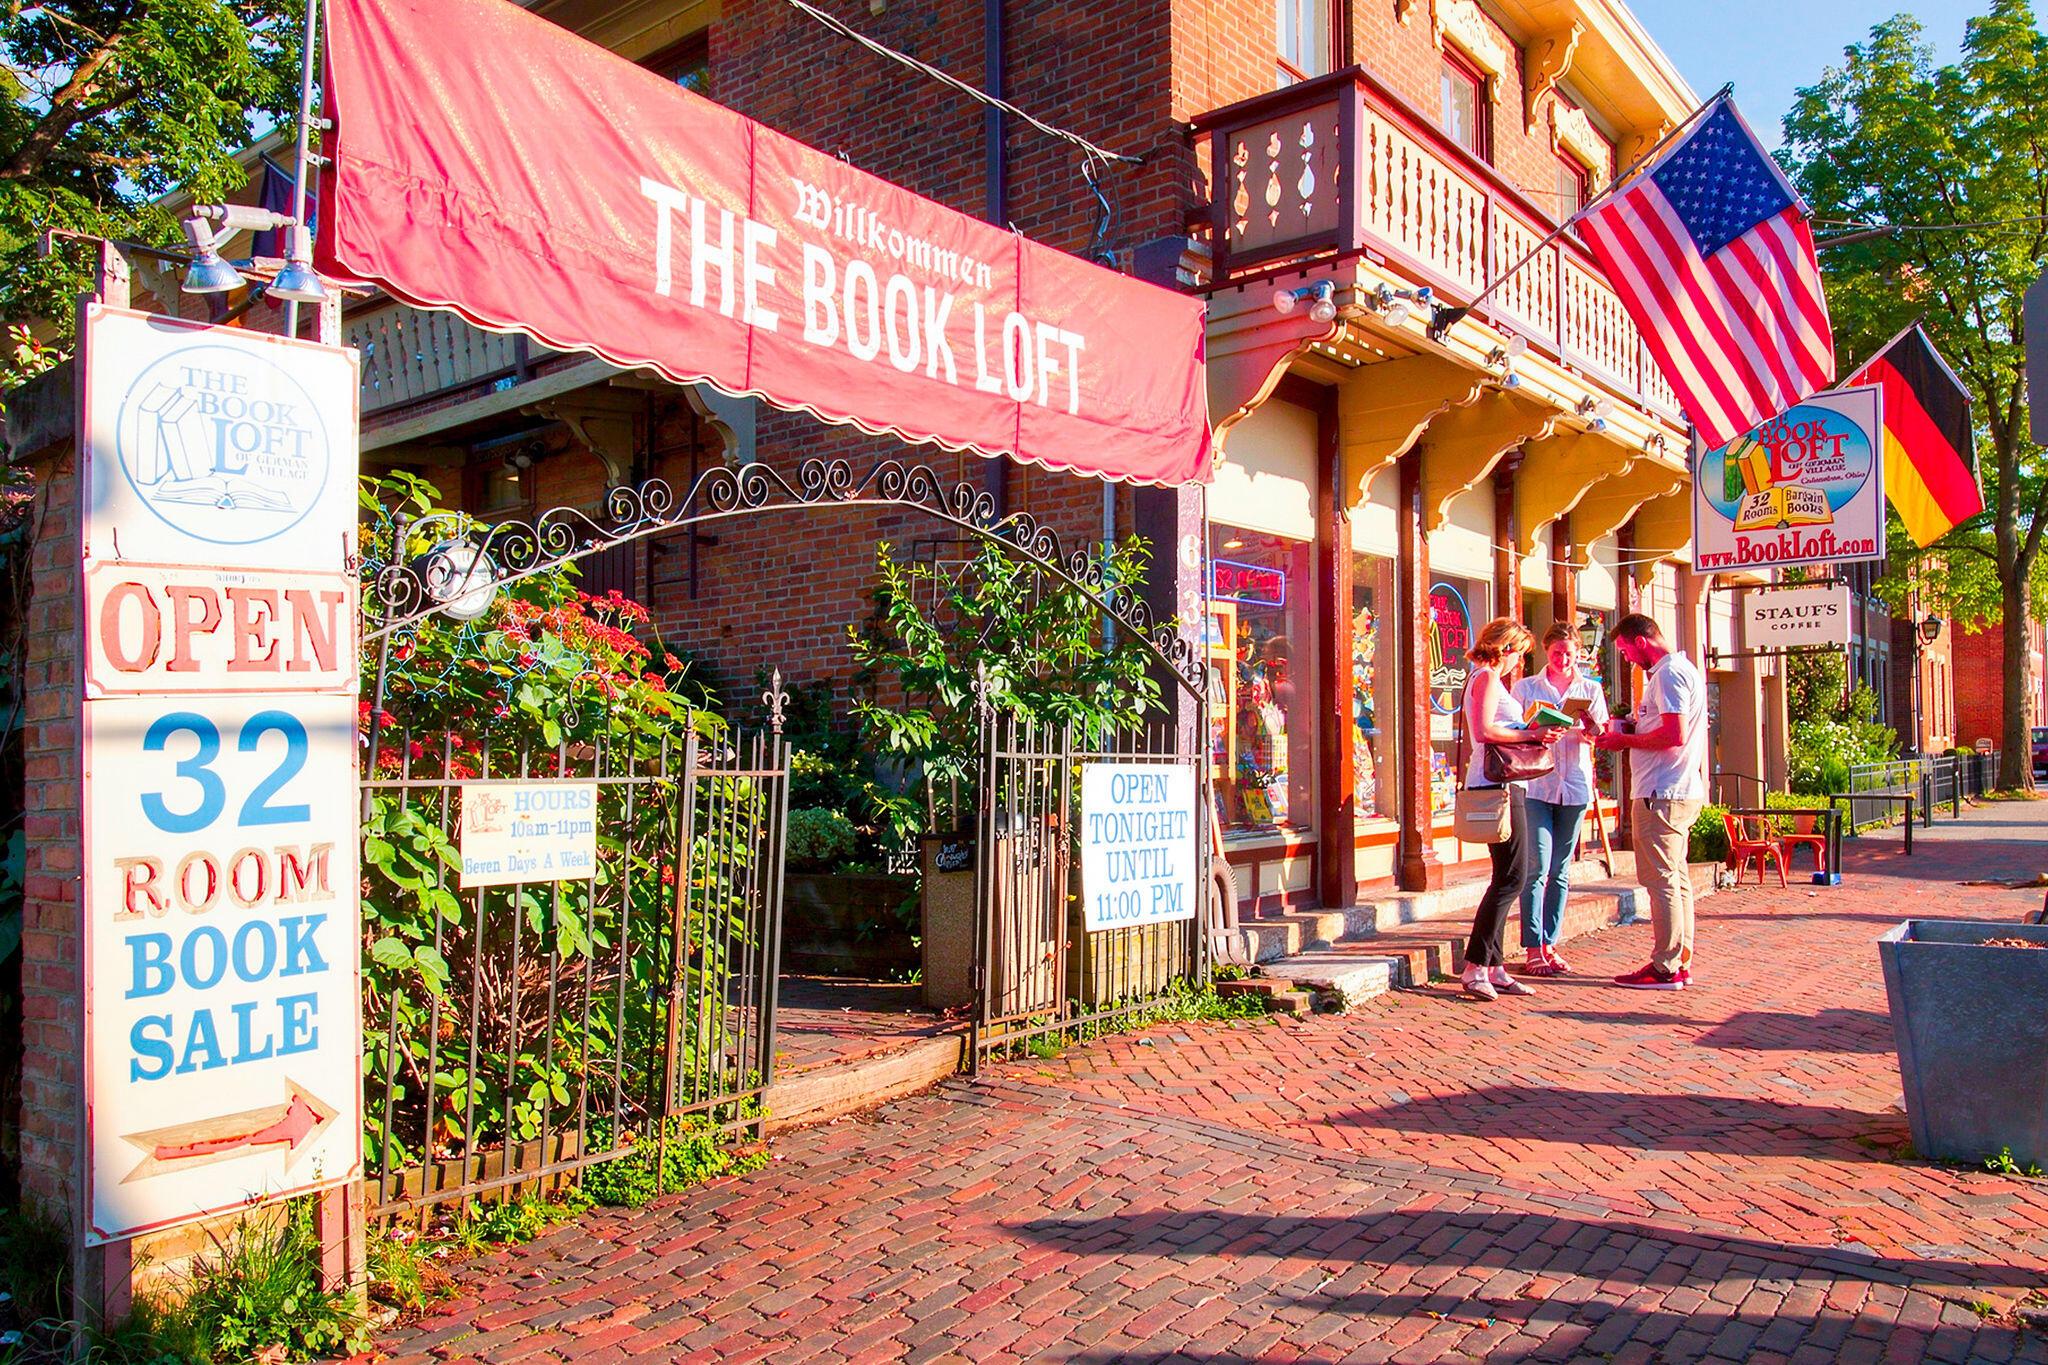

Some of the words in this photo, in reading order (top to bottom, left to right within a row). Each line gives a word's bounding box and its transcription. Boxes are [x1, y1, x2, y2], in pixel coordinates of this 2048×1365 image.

[790, 176, 992, 291] Willkommen
[640, 176, 779, 333] THE
[801, 242, 959, 385] BOOK
[974, 301, 1085, 415] LOFT
[180, 365, 248, 395] THE
[198, 391, 298, 426] BOOK
[211, 416, 312, 476] LOFT
[1758, 419, 1828, 446] BOOK
[256, 455, 309, 469] GERMAN
[1765, 433, 1849, 483] LOFT
[1750, 491, 1771, 510] 32
[1700, 529, 1875, 568] www.BookLoft.com
[100, 581, 344, 673] OPEN
[1755, 603, 1838, 621] STAUF'S
[1771, 621, 1821, 632] COFFEE
[140, 709, 312, 834] 32
[1111, 773, 1169, 804] OPEN
[514, 789, 592, 812] HOURS
[511, 820, 592, 840] 10am-11pm
[1090, 810, 1188, 845] TONIGHT
[508, 855, 537, 874] Days
[544, 853, 553, 869] A
[560, 850, 590, 868] Week
[1106, 847, 1174, 883] UNTIL
[113, 841, 336, 922] ROOM
[1097, 889, 1142, 922] 11:00
[1151, 882, 1184, 915] PM
[125, 912, 329, 1000] BOOK
[129, 991, 319, 1084] SALE
